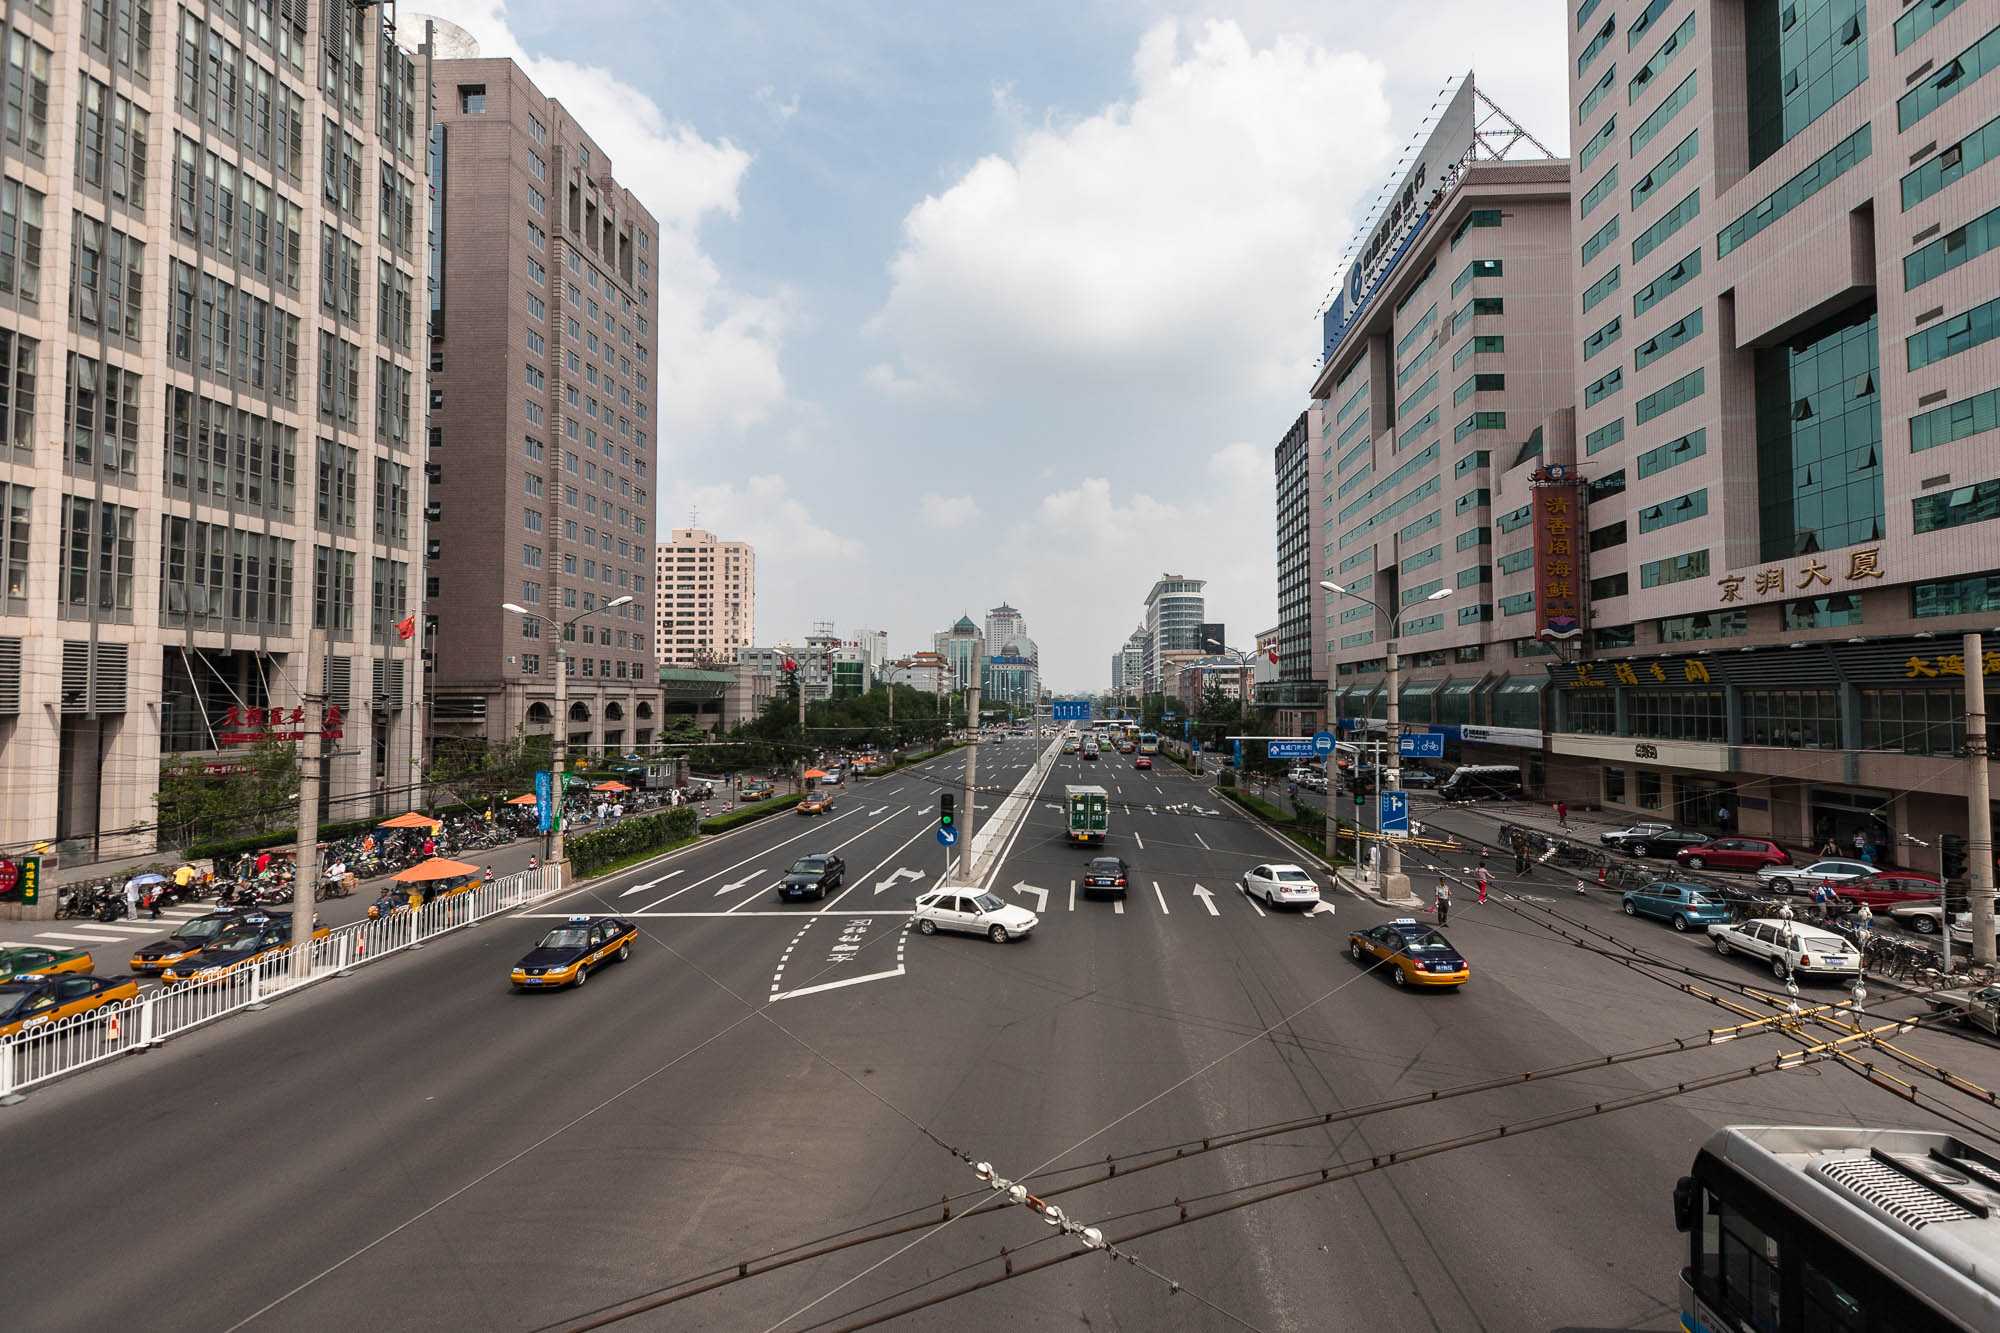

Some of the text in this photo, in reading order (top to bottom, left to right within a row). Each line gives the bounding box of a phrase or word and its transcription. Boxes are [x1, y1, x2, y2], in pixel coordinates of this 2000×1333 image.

[1363, 162, 1426, 271] 中国建设银行
[1375, 223, 1402, 268] Construction
[1403, 201, 1418, 226] Bank
[1544, 497, 1573, 599] 清香阁海鲜
[1717, 547, 1885, 602] 京润大厦
[222, 705, 345, 728] 天恒置业厦
